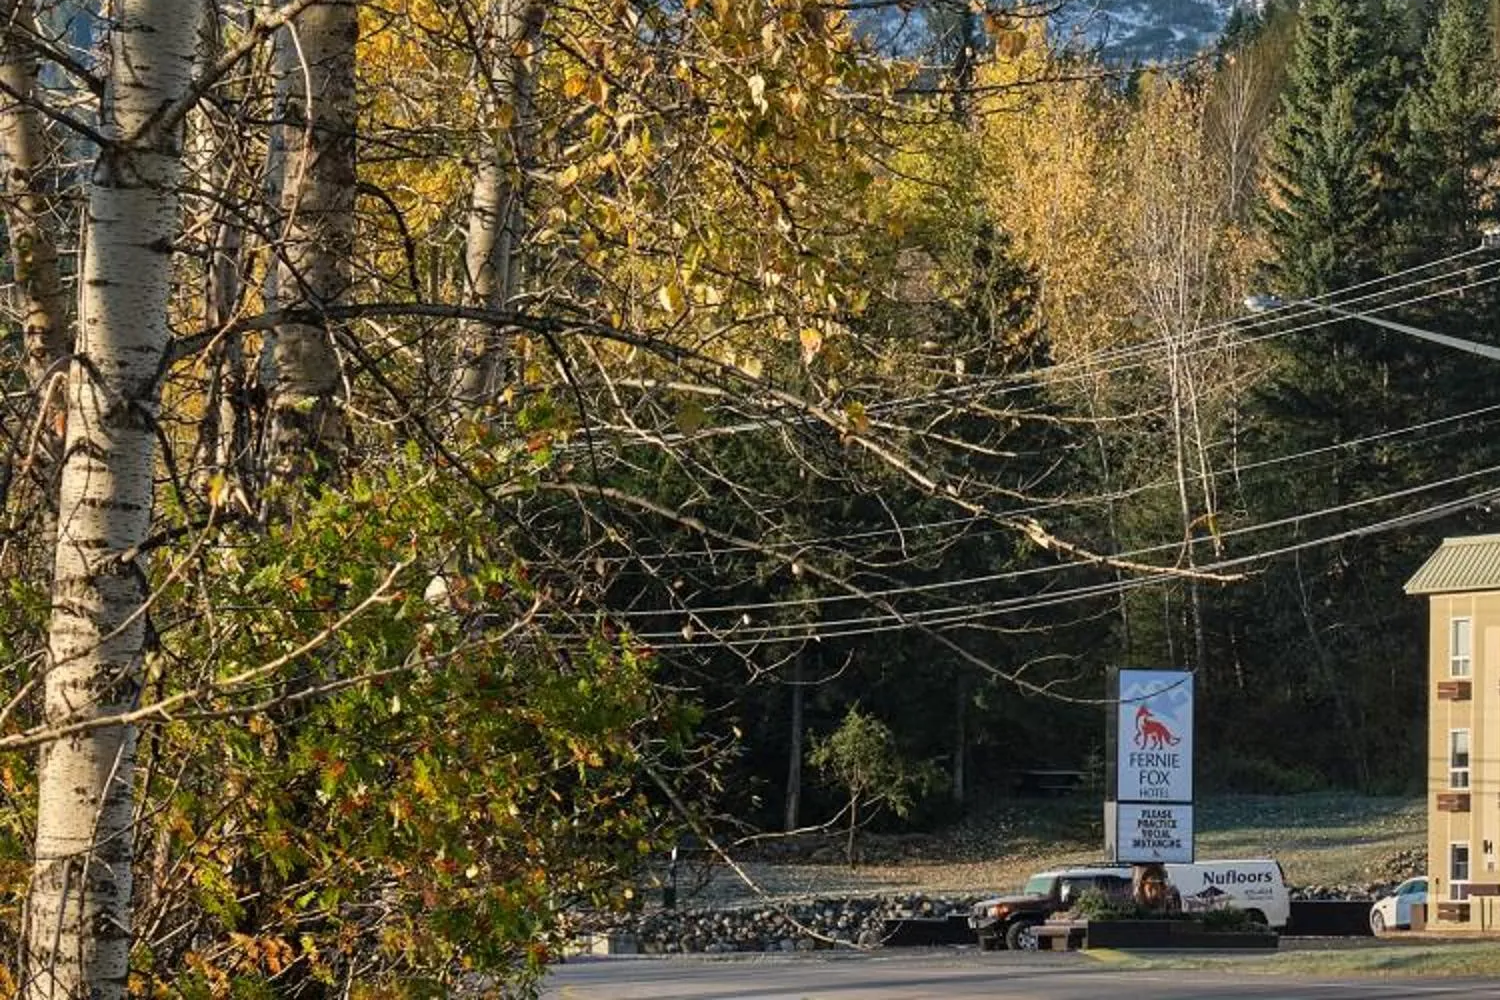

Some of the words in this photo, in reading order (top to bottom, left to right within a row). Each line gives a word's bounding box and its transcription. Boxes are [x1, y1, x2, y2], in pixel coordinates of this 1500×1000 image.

[1129, 752, 1181, 769] FERNIE
[1139, 770, 1170, 786] FOX
[1139, 787, 1169, 798] HOTEL
[1141, 809, 1172, 819] PLEASE
[1203, 869, 1273, 885] Nufloors
